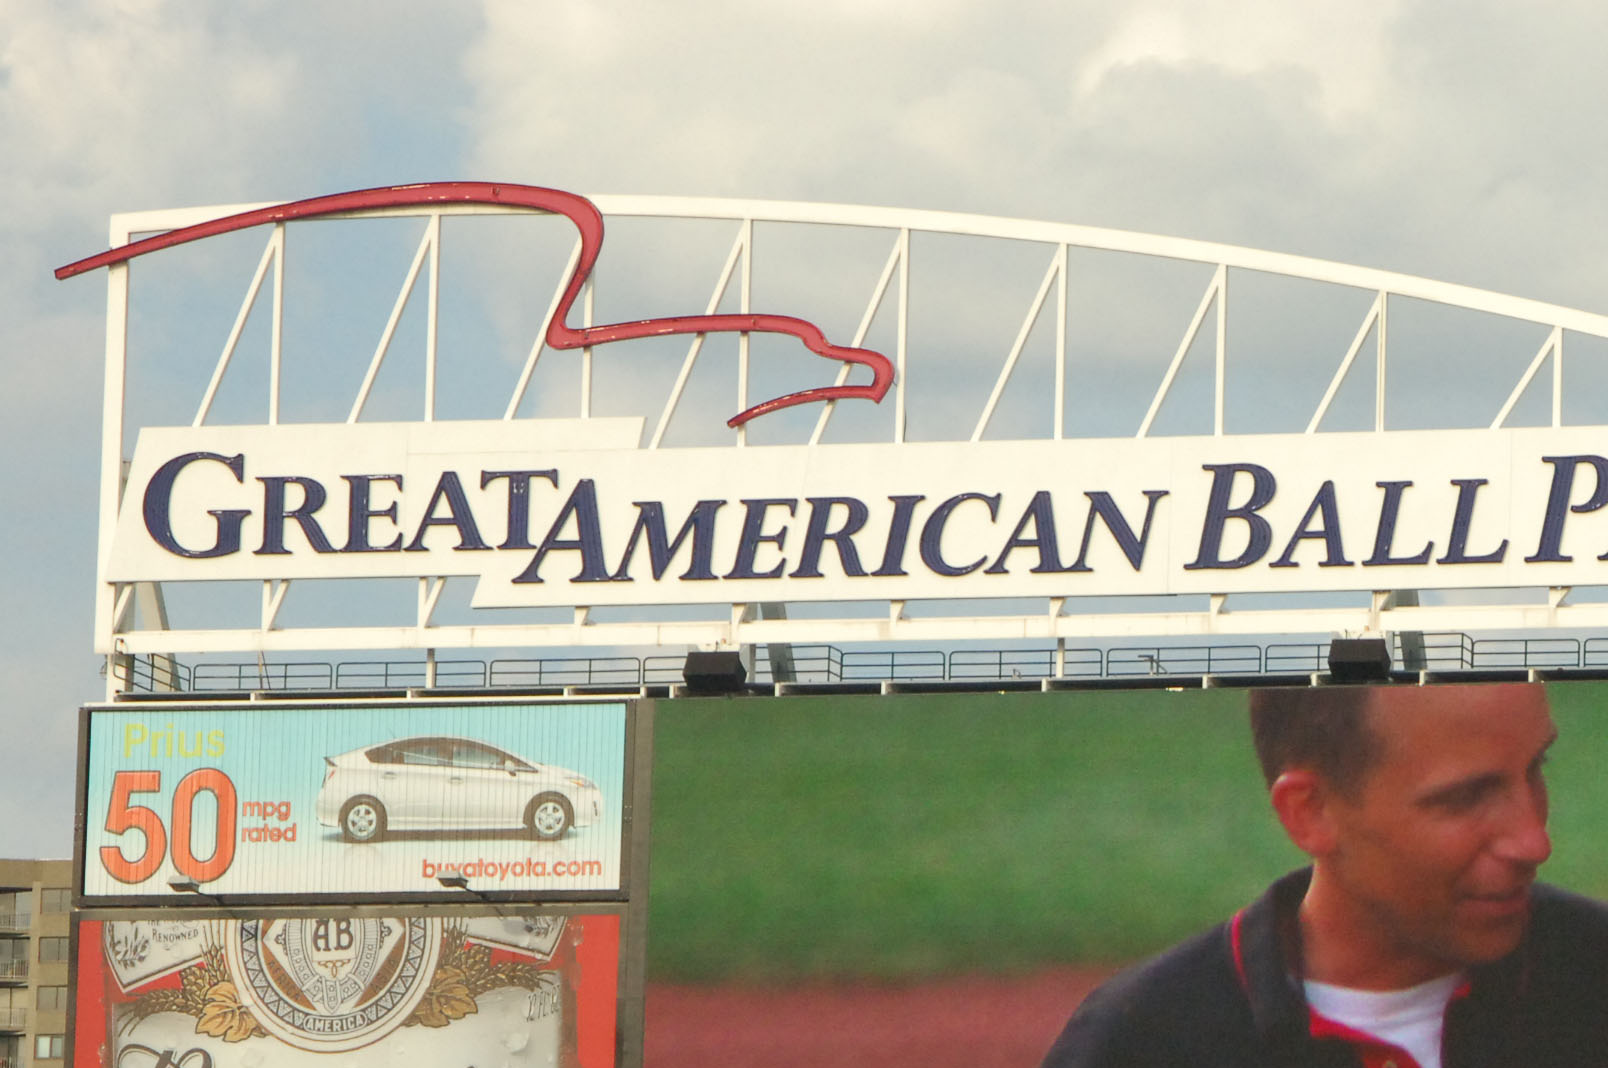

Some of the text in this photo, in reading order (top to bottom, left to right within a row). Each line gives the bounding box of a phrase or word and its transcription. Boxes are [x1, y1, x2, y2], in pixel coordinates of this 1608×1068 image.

[143, 451, 559, 559] GREAT
[511, 477, 1169, 584] AMERICAN
[1183, 462, 1509, 571] BALL
[123, 723, 226, 759] Prius
[242, 800, 292, 822] mpg
[99, 767, 238, 884] 50
[241, 823, 297, 843] rated
[152, 928, 199, 942] RENOWNED
[313, 917, 354, 951] AB
[306, 1016, 365, 1032] AMERICA
